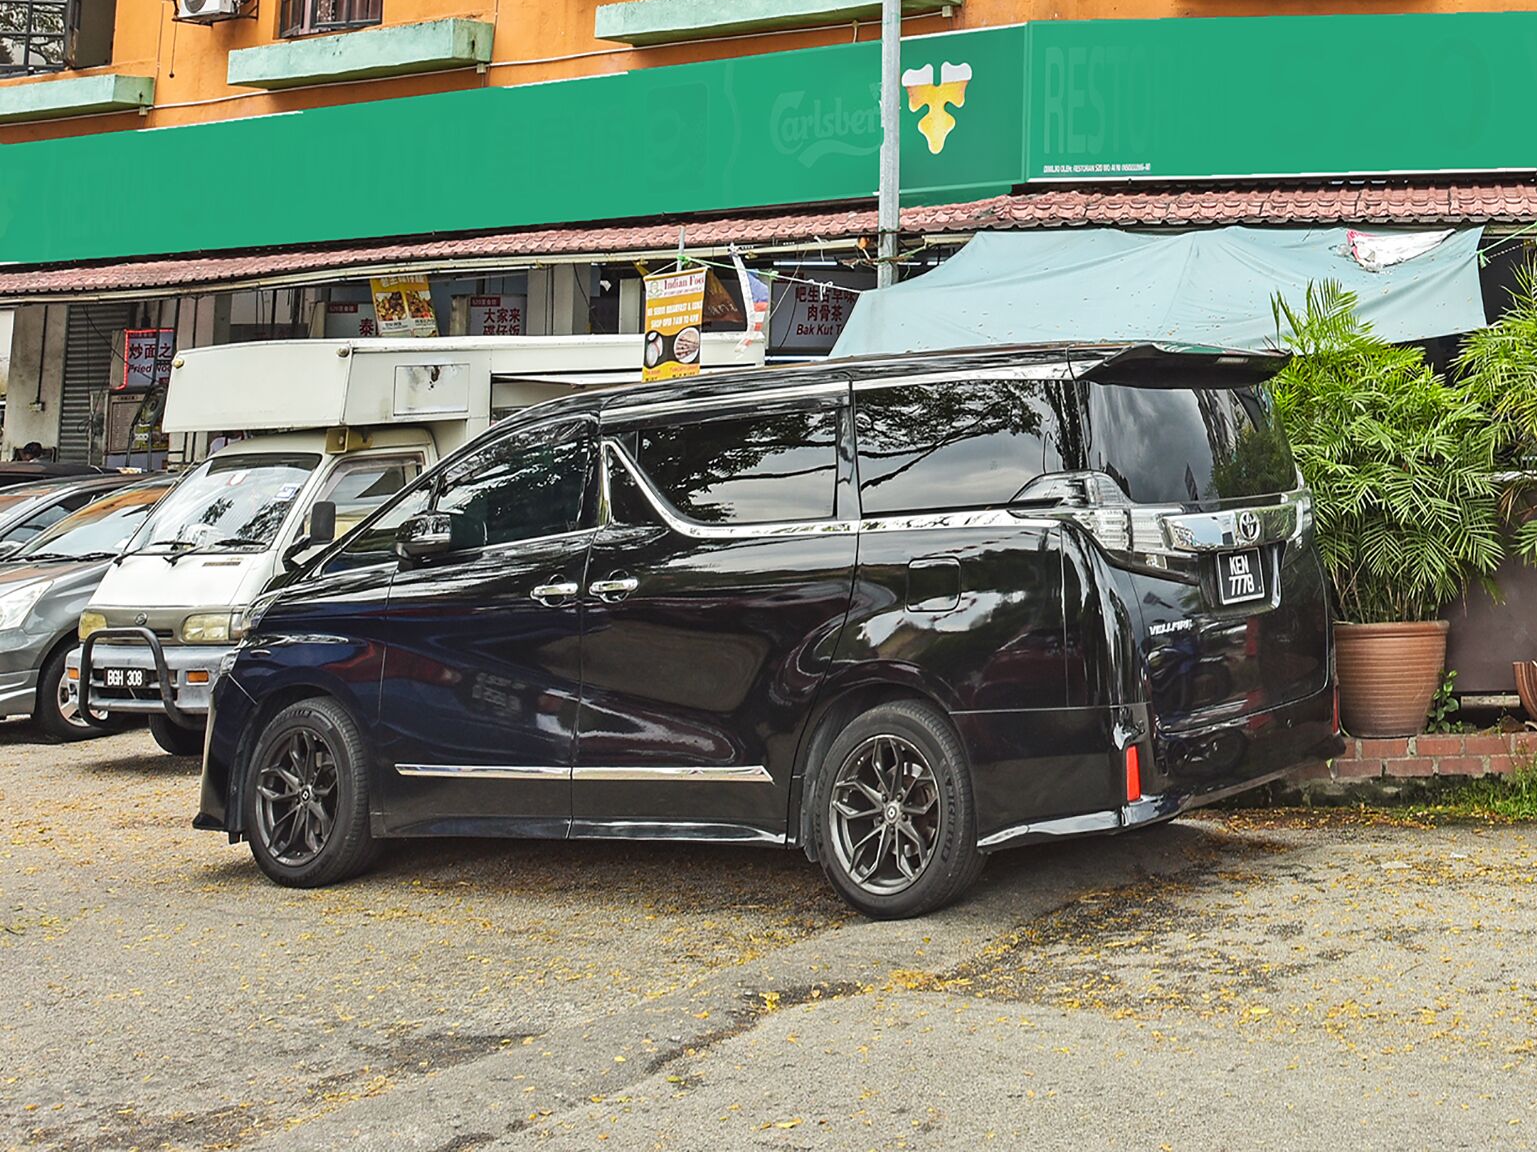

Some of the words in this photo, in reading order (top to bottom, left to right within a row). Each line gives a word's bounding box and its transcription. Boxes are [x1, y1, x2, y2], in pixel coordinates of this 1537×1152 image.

[769, 90, 882, 156] Carlsber
[664, 277, 688, 290] Indian
[484, 308, 521, 324] 大家来
[807, 305, 842, 322] 肉骨茶
[796, 324, 814, 336] Bak
[816, 324, 832, 336] Kut
[128, 363, 152, 374] Fried
[1228, 554, 1250, 575] KEN
[1228, 574, 1255, 597] 7778
[107, 669, 124, 686] BGH
